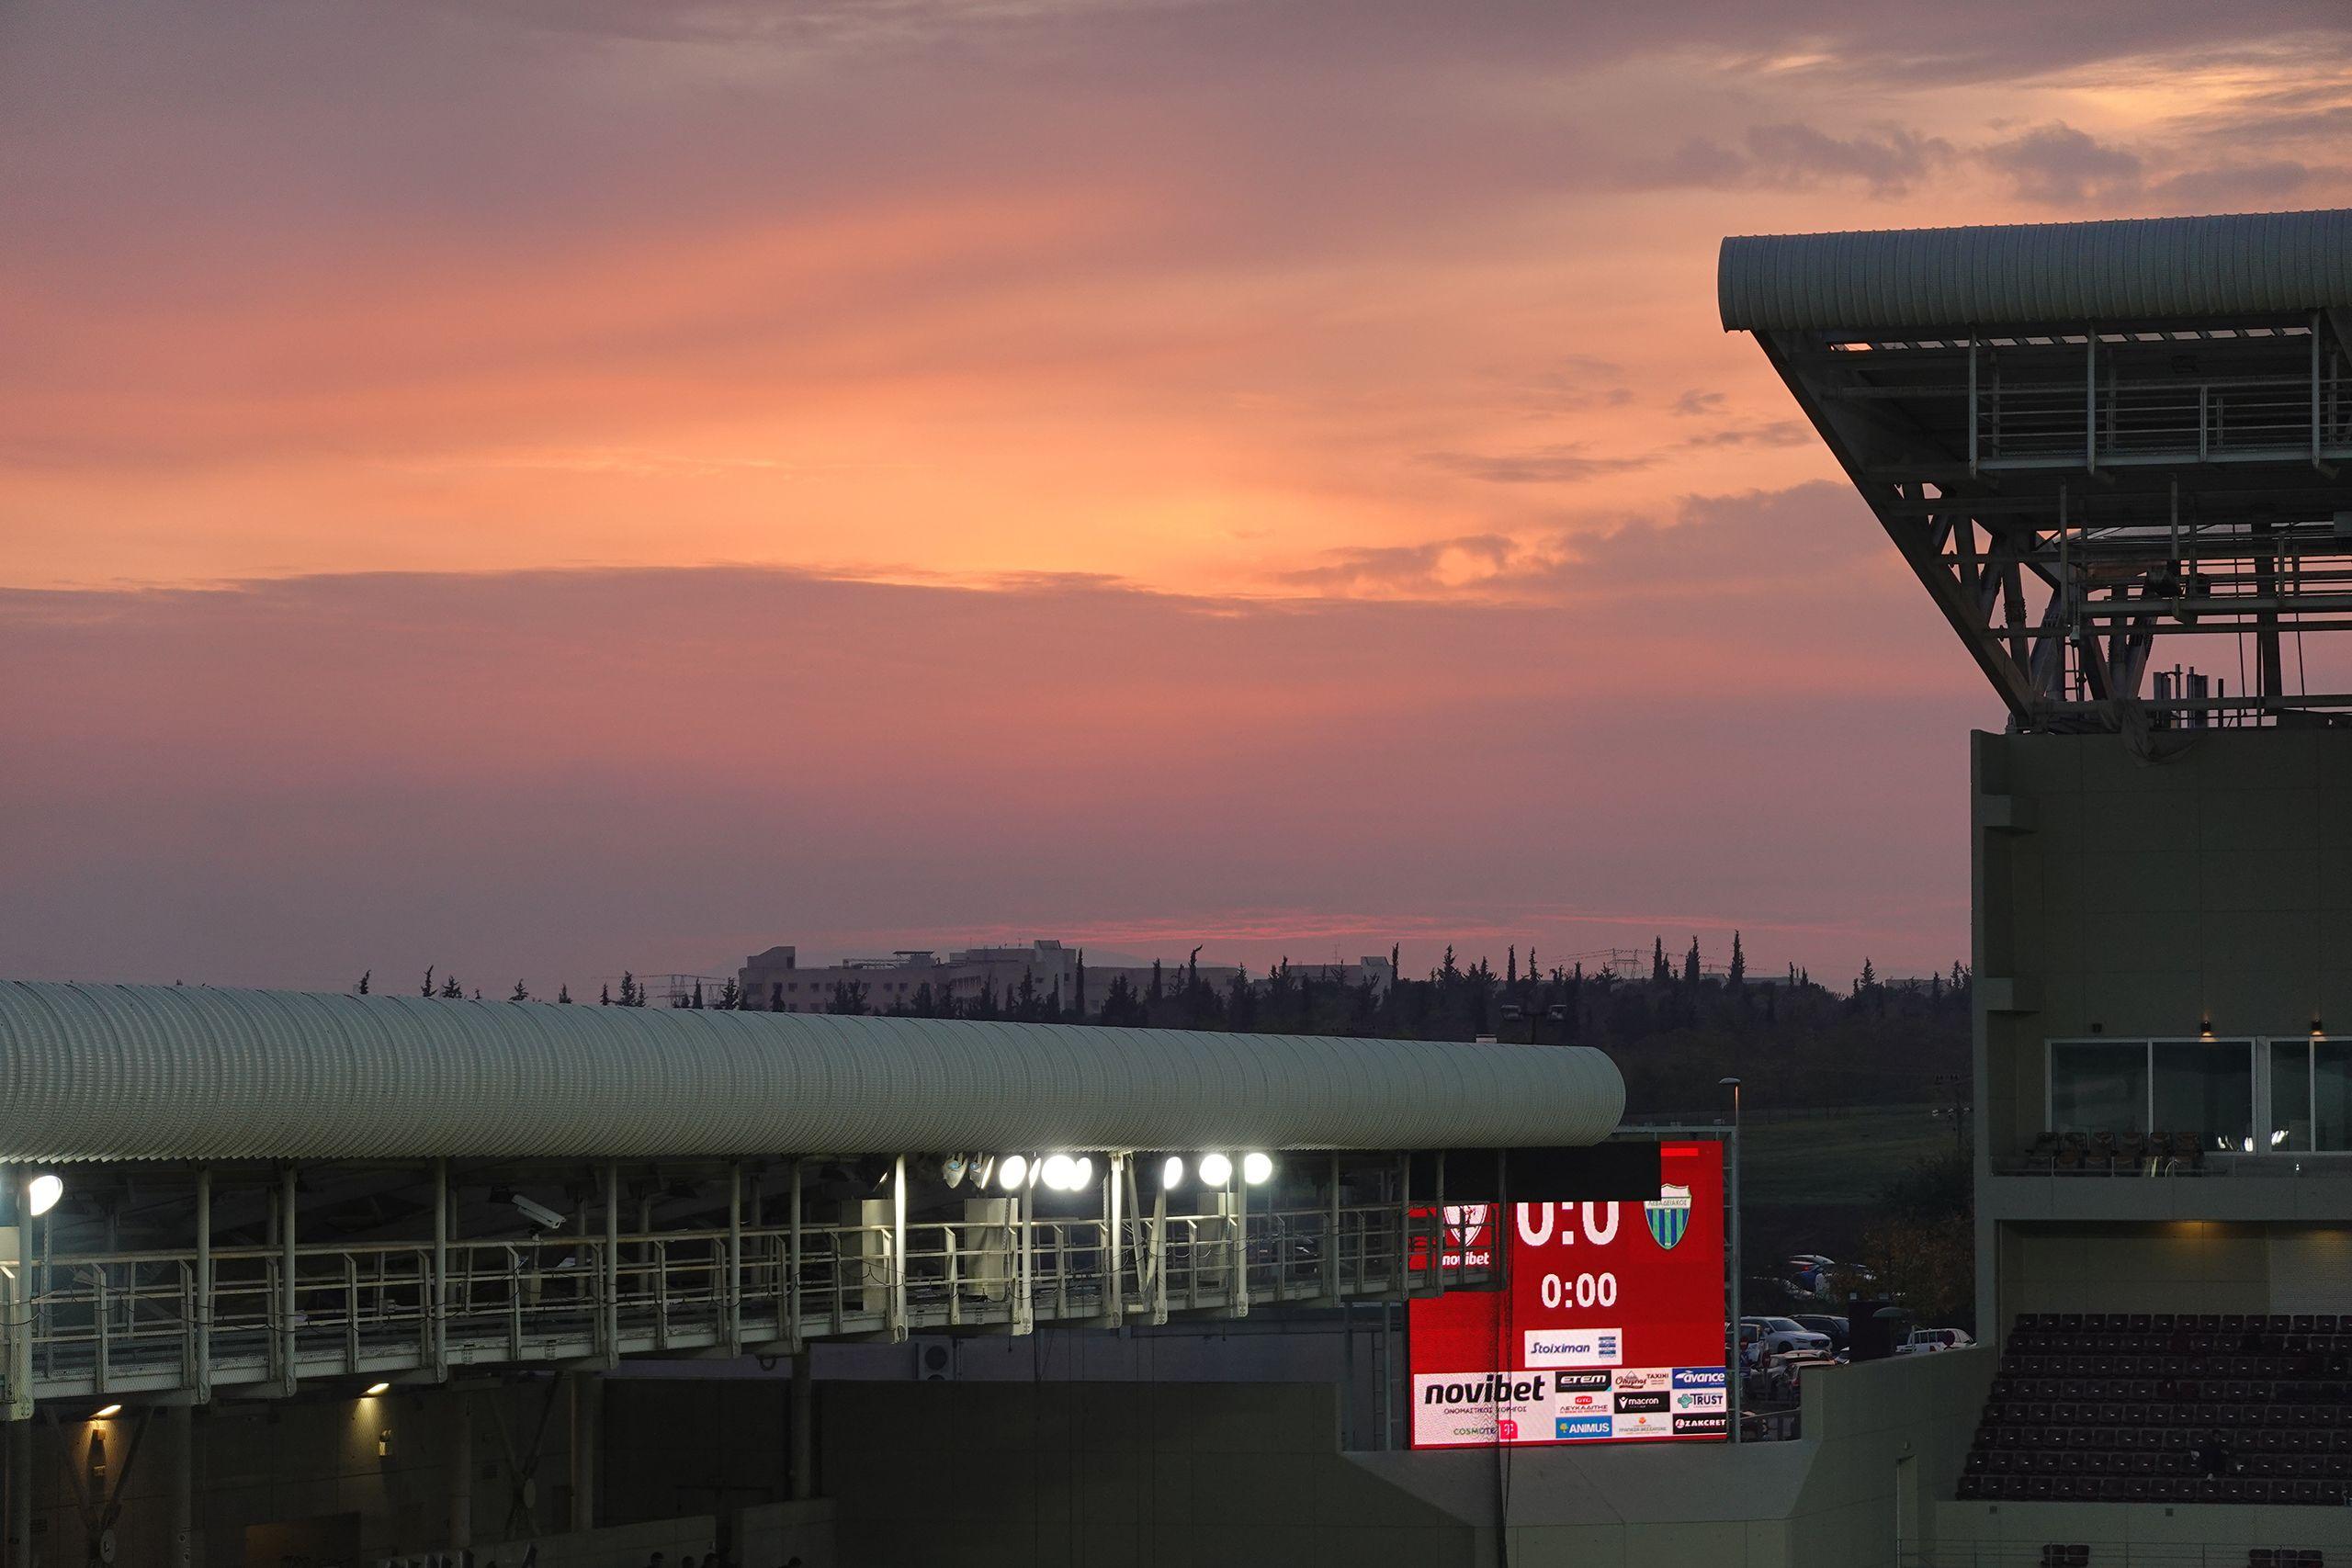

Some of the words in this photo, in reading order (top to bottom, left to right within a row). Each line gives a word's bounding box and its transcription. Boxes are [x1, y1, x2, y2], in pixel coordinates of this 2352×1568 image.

[1541, 1271, 1618, 1309] 0:00
[1531, 1342, 1590, 1354] Stoiximan
[1560, 1375, 1606, 1383] ETEM
[1683, 1371, 1725, 1382] avance
[1425, 1374, 1545, 1404] novibet
[1628, 1397, 1659, 1405] macron
[1690, 1393, 1724, 1405] TRUST
[1568, 1422, 1610, 1433] ANIMUS
[1684, 1419, 1726, 1427] ZAKCRET
